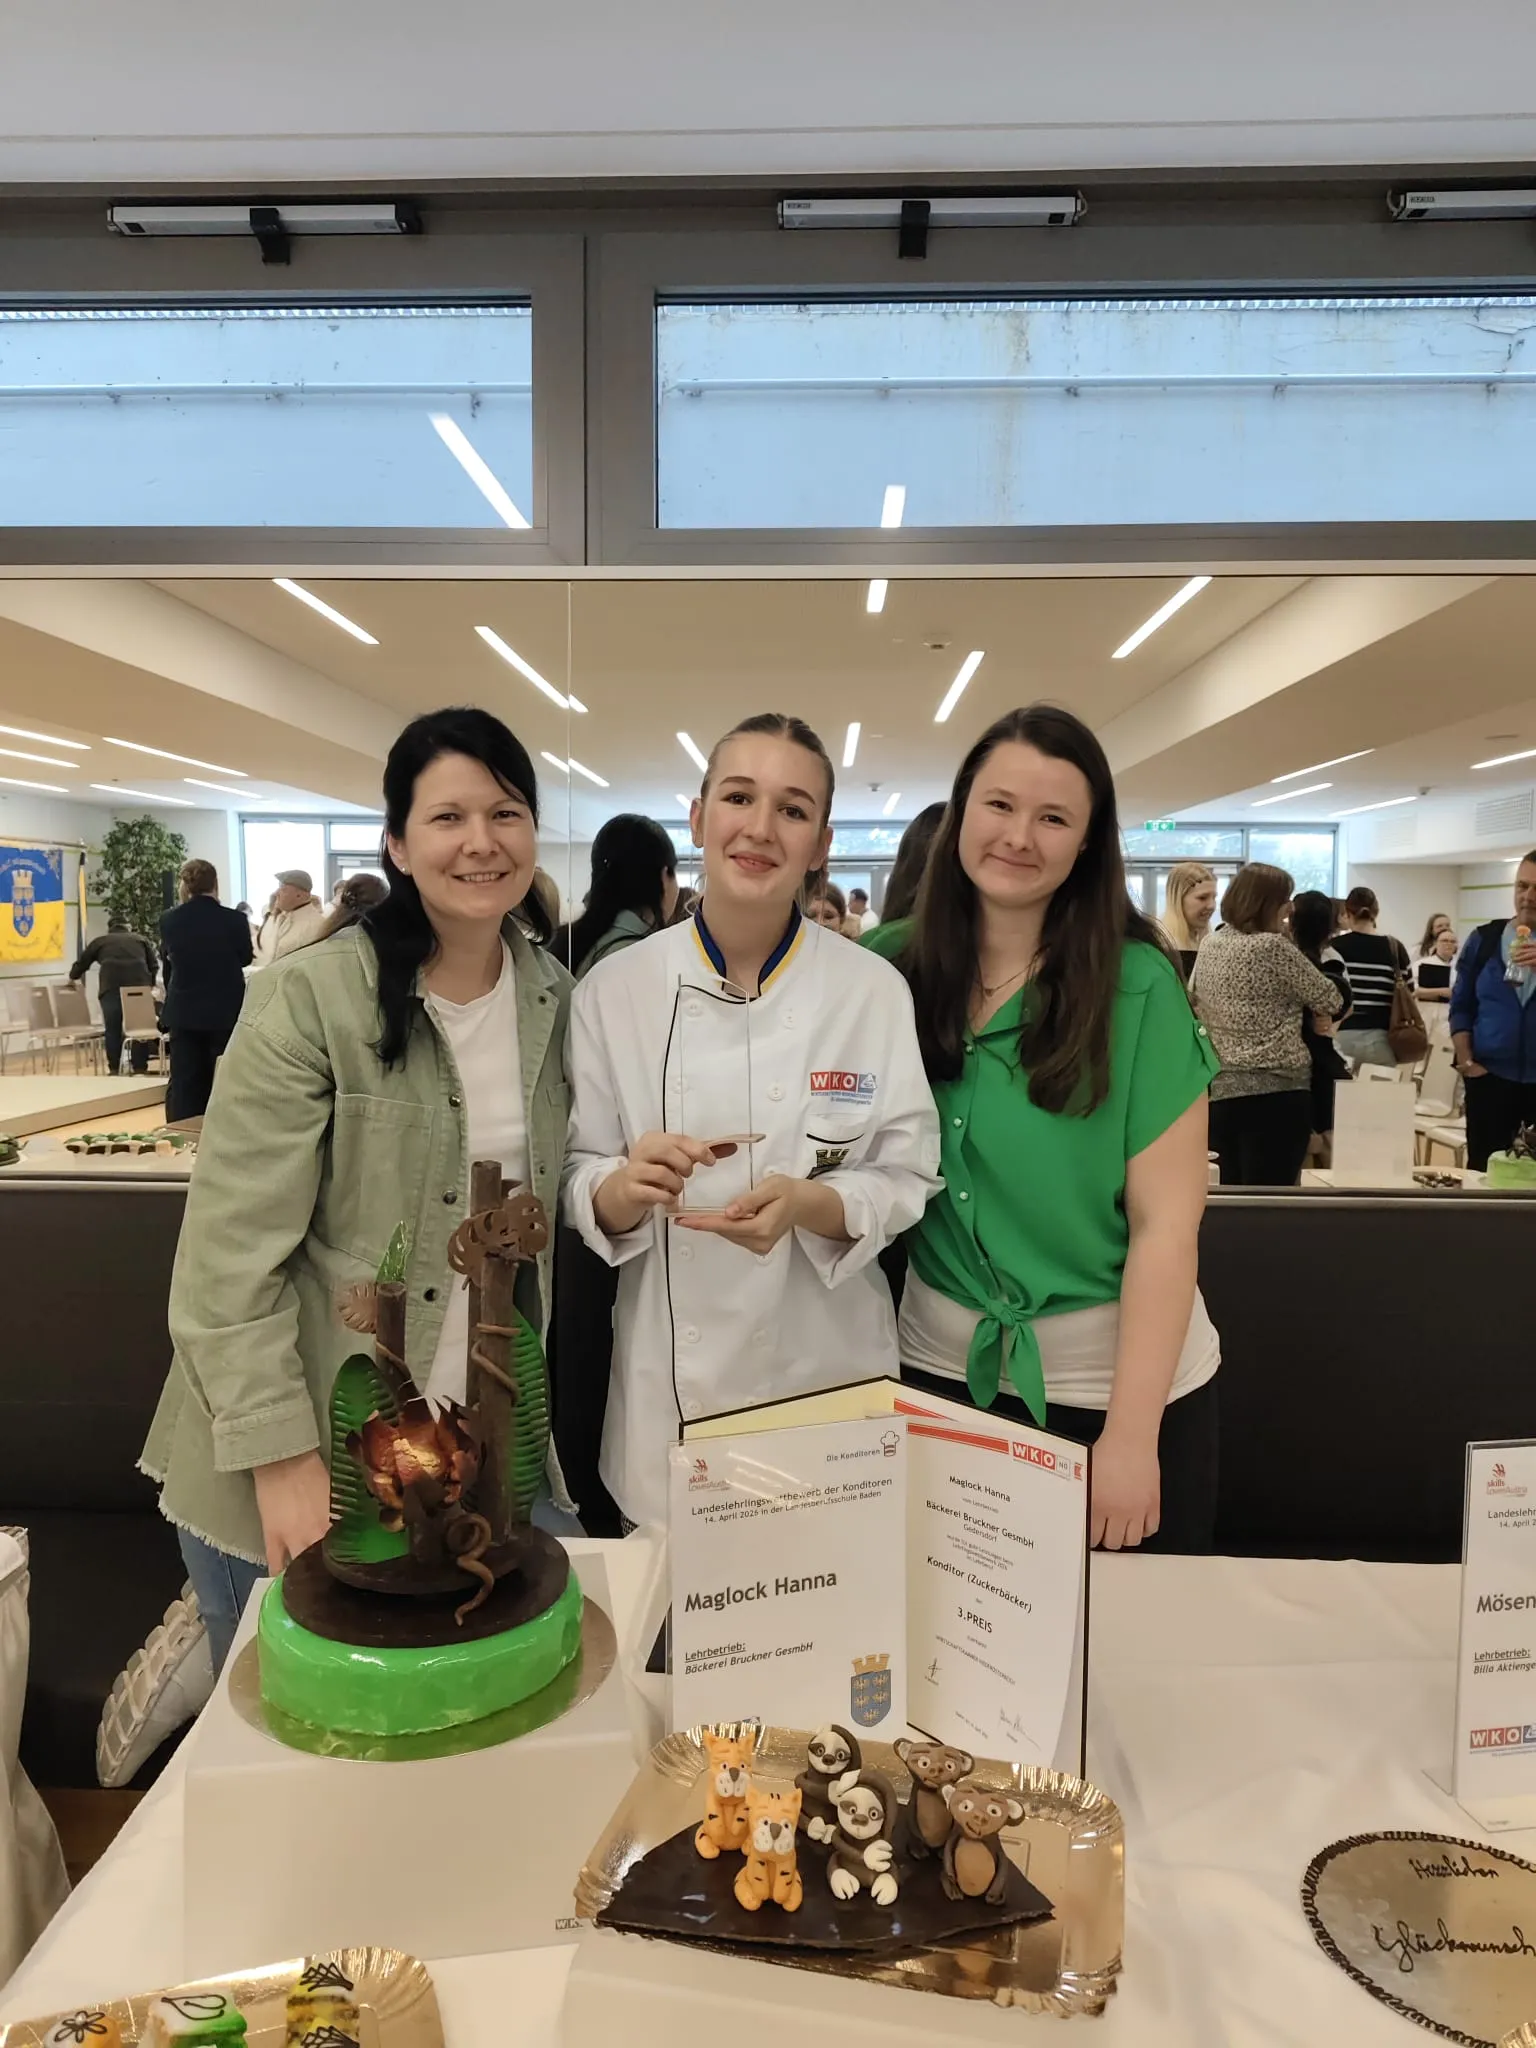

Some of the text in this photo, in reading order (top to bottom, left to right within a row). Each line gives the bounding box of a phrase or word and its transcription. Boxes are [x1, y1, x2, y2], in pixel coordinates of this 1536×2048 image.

[811, 1073, 856, 1089] WKO
[826, 1449, 881, 1462] Die Konditoren
[1013, 1443, 1055, 1468] WKO
[688, 1474, 708, 1484] skills
[824, 1486, 840, 1495] der
[842, 1478, 893, 1493] Konditoren
[949, 1475, 1011, 1502] Maglock Hanna
[1487, 1479, 1505, 1487] skills
[704, 1516, 717, 1524] 14.
[718, 1511, 738, 1522] April
[761, 1507, 769, 1515] in
[770, 1505, 783, 1514] der
[860, 1490, 882, 1500] Baden
[926, 1500, 961, 1519] Bäckerei
[963, 1512, 1000, 1534] Bruckner
[1002, 1528, 1035, 1549] GesmbH
[1512, 1519, 1530, 1529] April
[684, 1572, 837, 1612] Maglock Hanna
[927, 1555, 965, 1578] Konditor
[967, 1573, 1032, 1613] (Zuckerbäcker)
[1476, 1593, 1536, 1613] Mösen
[957, 1606, 993, 1633] 3.PREIS
[684, 1642, 747, 1662] Lehrbetrieb:
[685, 1642, 814, 1675] Bäckerei Bruckner GesmbH
[1474, 1648, 1531, 1662] Lehrbetrieb:
[1473, 1665, 1494, 1675] Billa
[1471, 1727, 1520, 1747] WKO
[556, 1918, 583, 1930] WK
